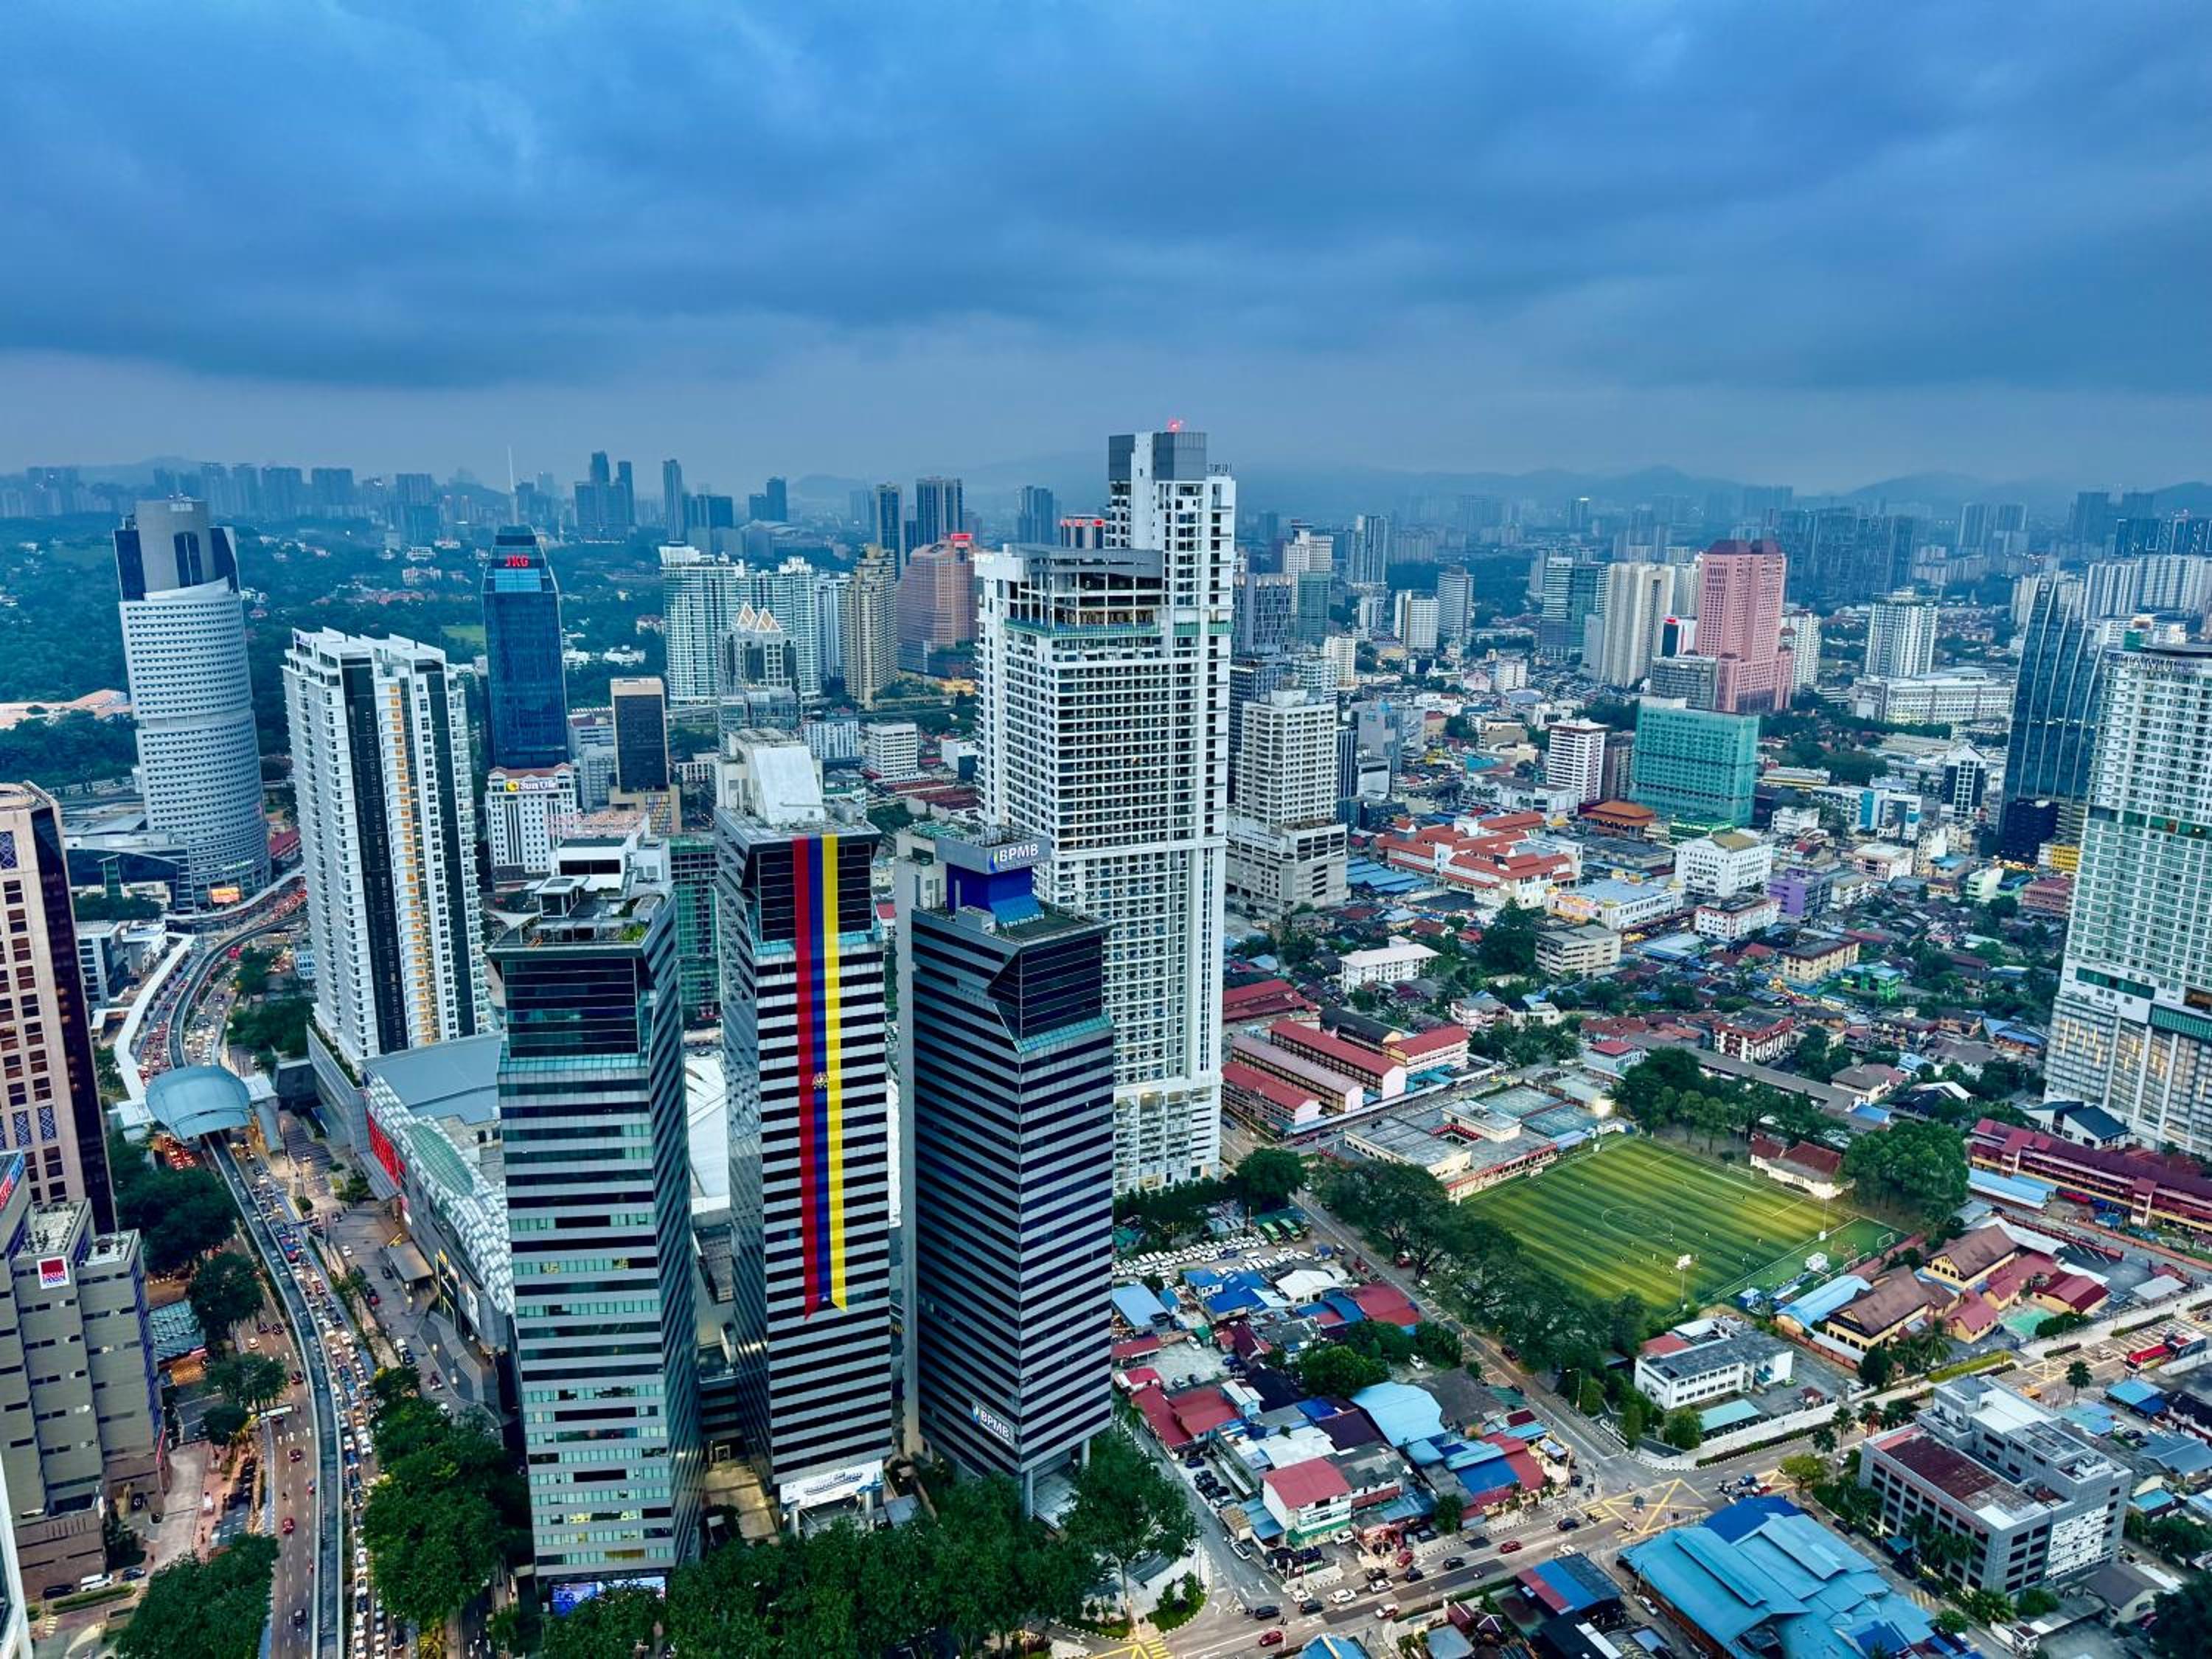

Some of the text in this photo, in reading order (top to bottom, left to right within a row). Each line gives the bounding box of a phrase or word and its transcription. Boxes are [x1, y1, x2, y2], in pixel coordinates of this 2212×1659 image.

[505, 554, 529, 567] JKG
[999, 843, 1039, 862] BPMB
[981, 1409, 1009, 1438] BPMB
